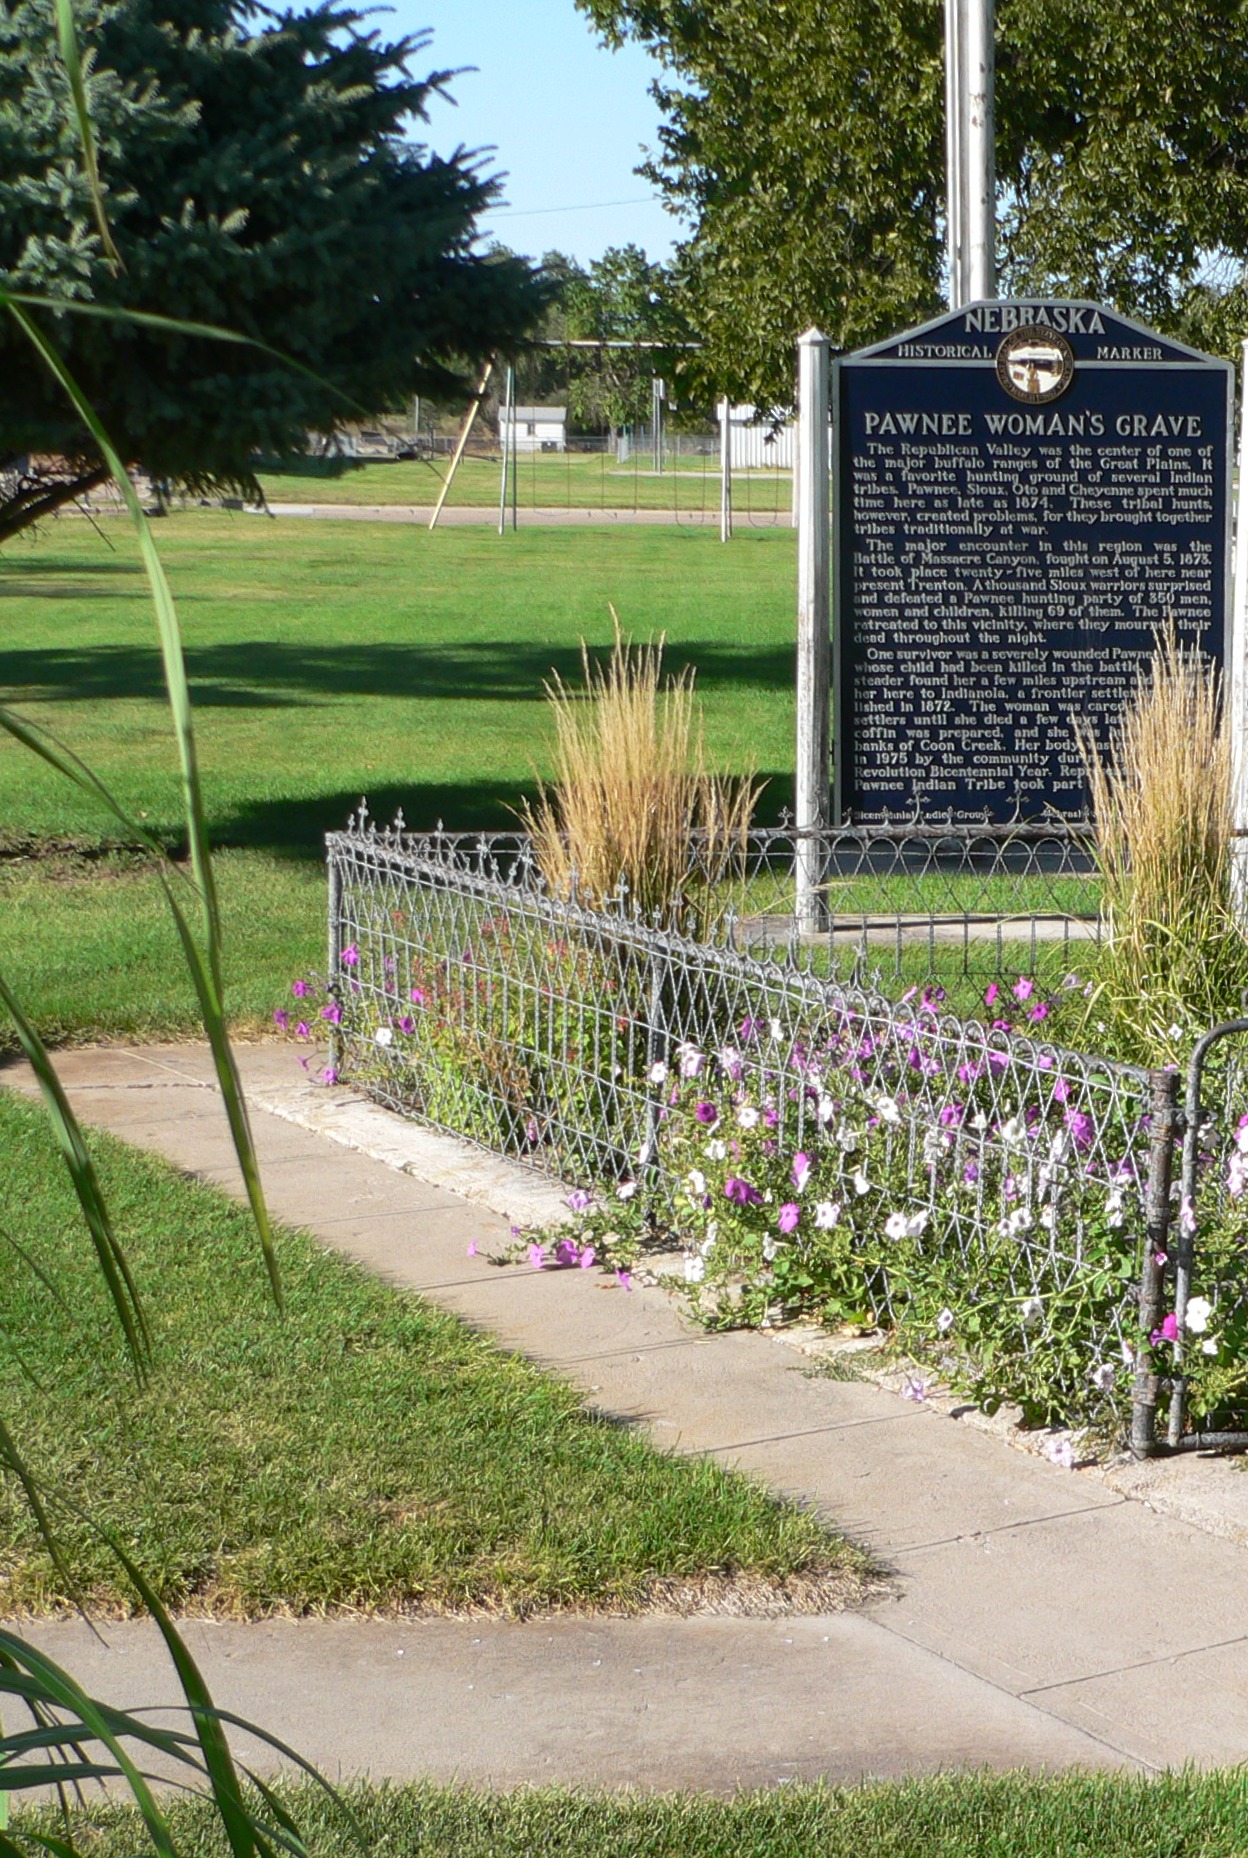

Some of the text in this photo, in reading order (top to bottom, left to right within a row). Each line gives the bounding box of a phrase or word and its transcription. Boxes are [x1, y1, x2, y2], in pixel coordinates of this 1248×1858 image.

[964, 306, 1106, 335] NEBRASKA
[898, 345, 1162, 360] HISTORICAL MARKER
[865, 410, 1202, 437] PAWNEE WOMAN'S GRAVE
[867, 443, 1214, 458] The Republican Valley was the center one of
[853, 456, 1212, 471] the major buffalo ranges the Great Plains. It
[853, 469, 1212, 484] was favorite hunting ground several Indian
[853, 482, 898, 494] tribes.
[1012, 482, 1038, 495] Oto
[1041, 482, 1066, 495] and
[1068, 483, 1134, 498] Cheyenne
[1137, 484, 1174, 498] spent
[1177, 483, 1212, 496] much
[853, 495, 884, 508] time
[893, 495, 926, 508] here
[957, 495, 984, 508] late
[1015, 496, 1054, 508] 1874.
[1069, 496, 1112, 508] These
[1121, 496, 1162, 509] tribal
[916, 509, 970, 521] created
[1042, 509, 1064, 521] for
[1065, 509, 1098, 524] they
[1100, 509, 1152, 524] brought
[1155, 509, 1212, 524] together
[853, 522, 896, 534] tribes
[903, 522, 992, 537] traditionally
[1000, 523, 1014, 534] at
[866, 539, 1212, 554] The major encounter in this region was the
[853, 552, 894, 565] Battle
[921, 552, 982, 565] Massacre
[1045, 552, 1090, 567] fought
[1091, 555, 1108, 565] on
[1112, 552, 1160, 567] August
[870, 565, 902, 578] took
[910, 565, 948, 580] place
[1048, 565, 1084, 578] miles
[1089, 566, 1120, 578] west
[1145, 565, 1176, 578] here
[1180, 568, 1212, 578] near
[853, 578, 1212, 593] present Trenton. thousand Sioux warriors surprised
[884, 591, 942, 604] defeated
[964, 591, 1014, 604] Pawnee
[1021, 591, 1076, 606] hunting
[1082, 592, 1122, 606] party
[1128, 591, 1144, 604] of
[1149, 591, 1174, 604] 350
[853, 607, 898, 617] women
[998, 604, 1044, 619] killing
[1047, 604, 1064, 617] 69
[1088, 604, 1124, 617] them.
[1132, 604, 1158, 617] The
[941, 617, 966, 630] this
[1033, 617, 1074, 630] where
[1077, 617, 1110, 632] they
[1177, 617, 1212, 630] their
[892, 630, 1046, 645] throughout the night.
[867, 647, 1110, 662] One survivor was severely wounded
[899, 660, 934, 673] child
[940, 660, 964, 673] had
[970, 660, 1002, 673] been
[1008, 660, 1046, 673] killed
[1070, 660, 1094, 673] the
[909, 673, 1126, 688] found her few miles upstream
[883, 686, 914, 699] here
[1031, 686, 1086, 699] frontier
[921, 699, 954, 712] 1872.
[968, 699, 996, 712] The
[1004, 702, 1050, 712] woman
[1057, 702, 1080, 712] was
[913, 712, 1058, 725] until she died few
[853, 726, 896, 738] coffin
[905, 729, 930, 738] was
[1047, 725, 1068, 738] she
[853, 738, 1086, 753] banks Coon Creek. Her body
[876, 752, 1050, 767] 1975 by the community
[853, 765, 1052, 778] Revolution Bicentennial Year.
[853, 778, 1082, 792] Pawnee Tribe part
